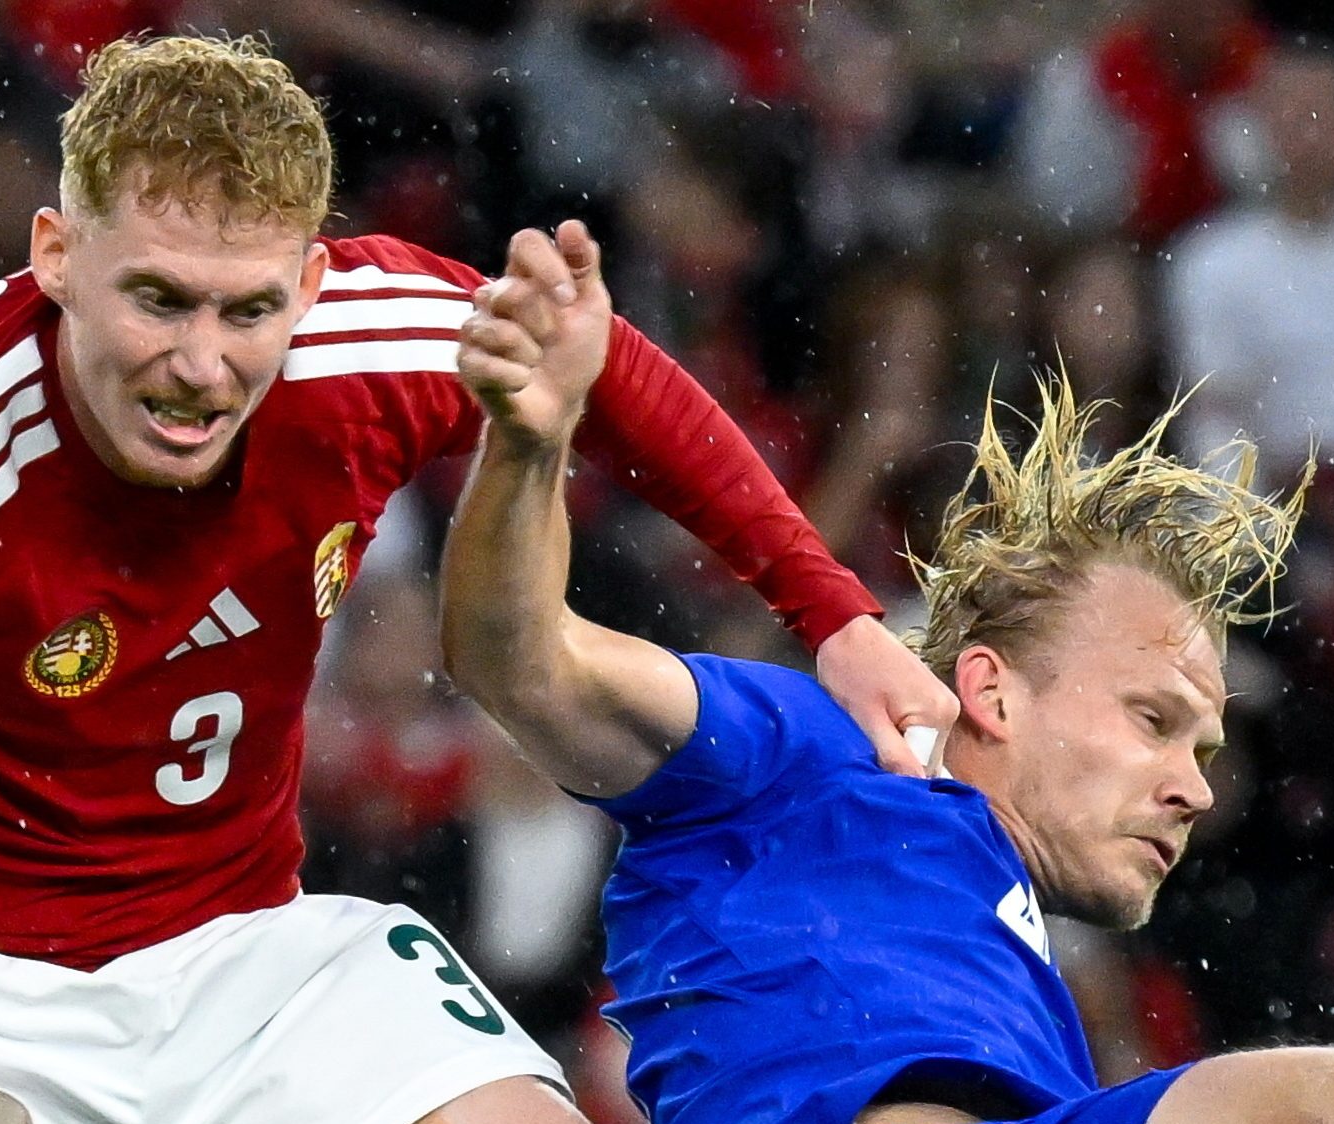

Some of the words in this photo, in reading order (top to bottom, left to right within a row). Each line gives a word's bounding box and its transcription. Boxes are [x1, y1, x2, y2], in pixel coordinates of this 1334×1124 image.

[54, 684, 82, 698] 125
[155, 690, 243, 806] 3
[386, 923, 506, 1036] 3
